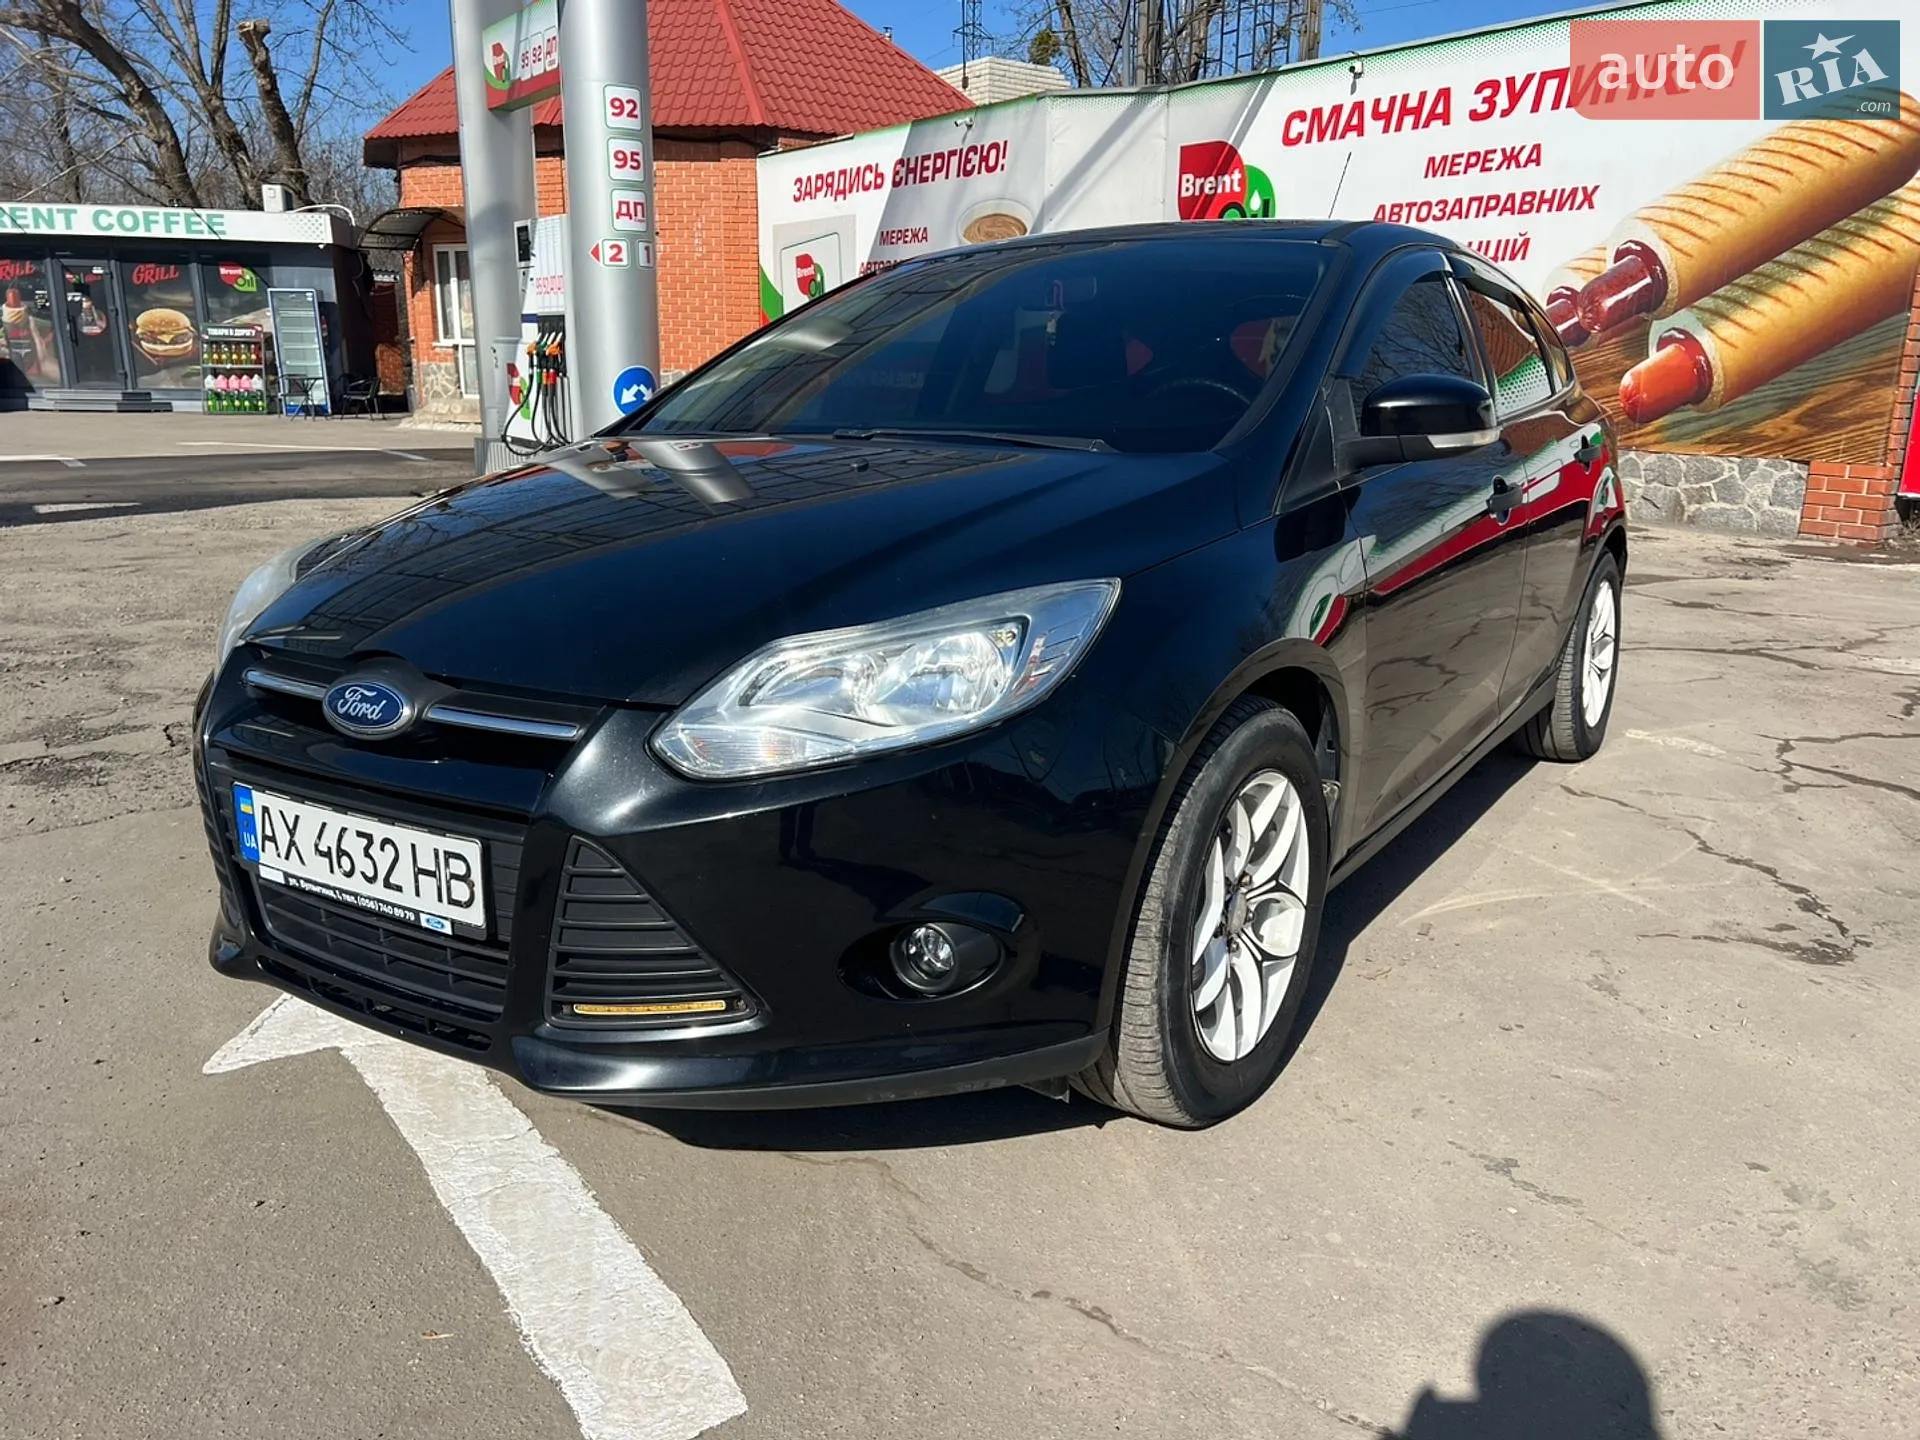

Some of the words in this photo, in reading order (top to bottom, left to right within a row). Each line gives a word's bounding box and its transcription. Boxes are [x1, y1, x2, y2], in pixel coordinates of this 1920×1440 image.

[532, 45, 542, 63] 92
[609, 97, 639, 119] 92
[1281, 96, 1451, 147] СМАЧНА
[613, 150, 642, 171] 95
[793, 163, 885, 203] ЗАРЯДИСЬ
[891, 140, 1008, 189] ЄНЕРГІЄЮ!
[1424, 143, 1542, 179] МЕРЕЖА
[1180, 167, 1242, 198] Brent
[616, 200, 646, 220] ДП
[1373, 184, 1601, 224] АВТОЗАПРАВНИХ
[92, 207, 228, 237] COFFEE
[879, 227, 928, 246] МЕРЕЖА
[608, 243, 623, 263] 2
[644, 246, 651, 264] 1
[132, 264, 180, 286] GRILL
[337, 686, 387, 721] Ford
[243, 833, 257, 849] UA
[260, 805, 306, 866] AX
[314, 821, 403, 893] 4632
[410, 842, 476, 909] HB
